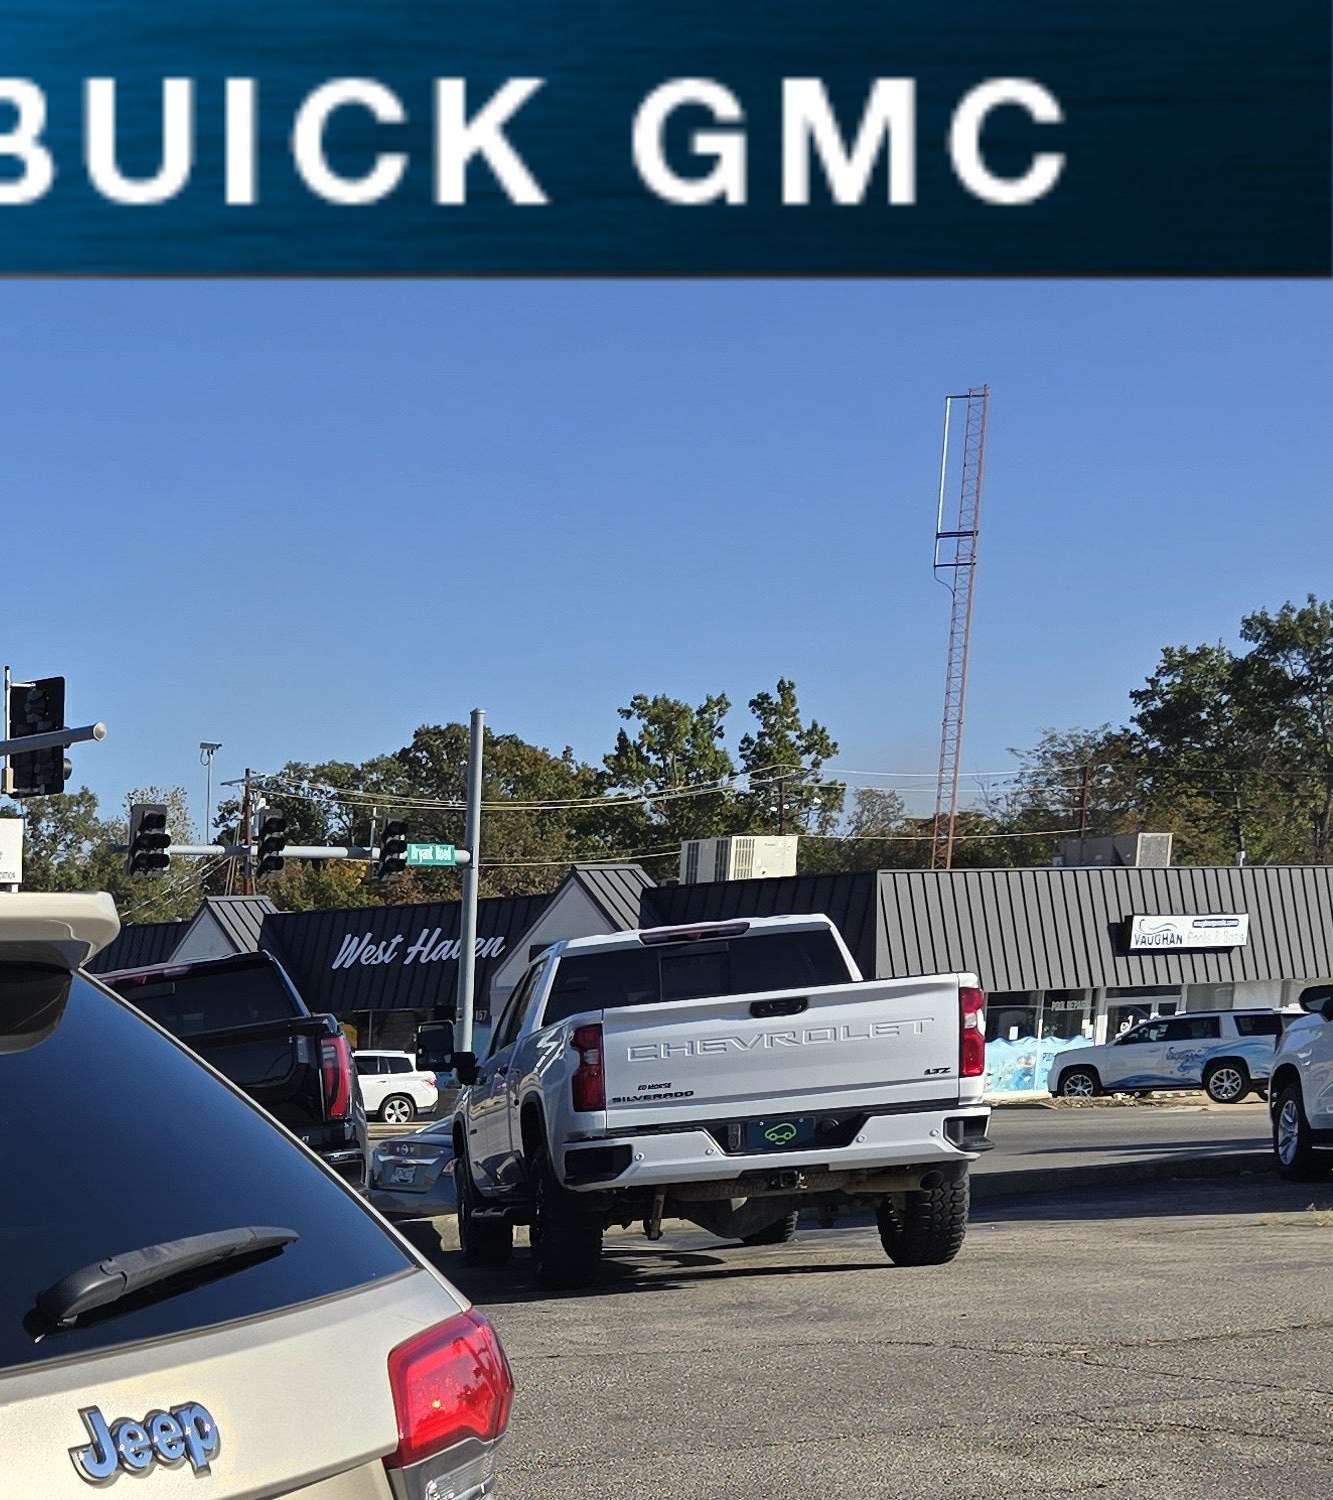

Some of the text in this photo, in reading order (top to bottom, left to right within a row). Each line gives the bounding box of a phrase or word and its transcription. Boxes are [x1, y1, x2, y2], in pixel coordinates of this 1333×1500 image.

[331, 932, 404, 970] West
[1134, 933, 1183, 945] VAUGHAN
[627, 1017, 934, 1062] CHEVROLET
[611, 1090, 695, 1104] SILVERADO
[67, 1400, 221, 1485] Jeep
